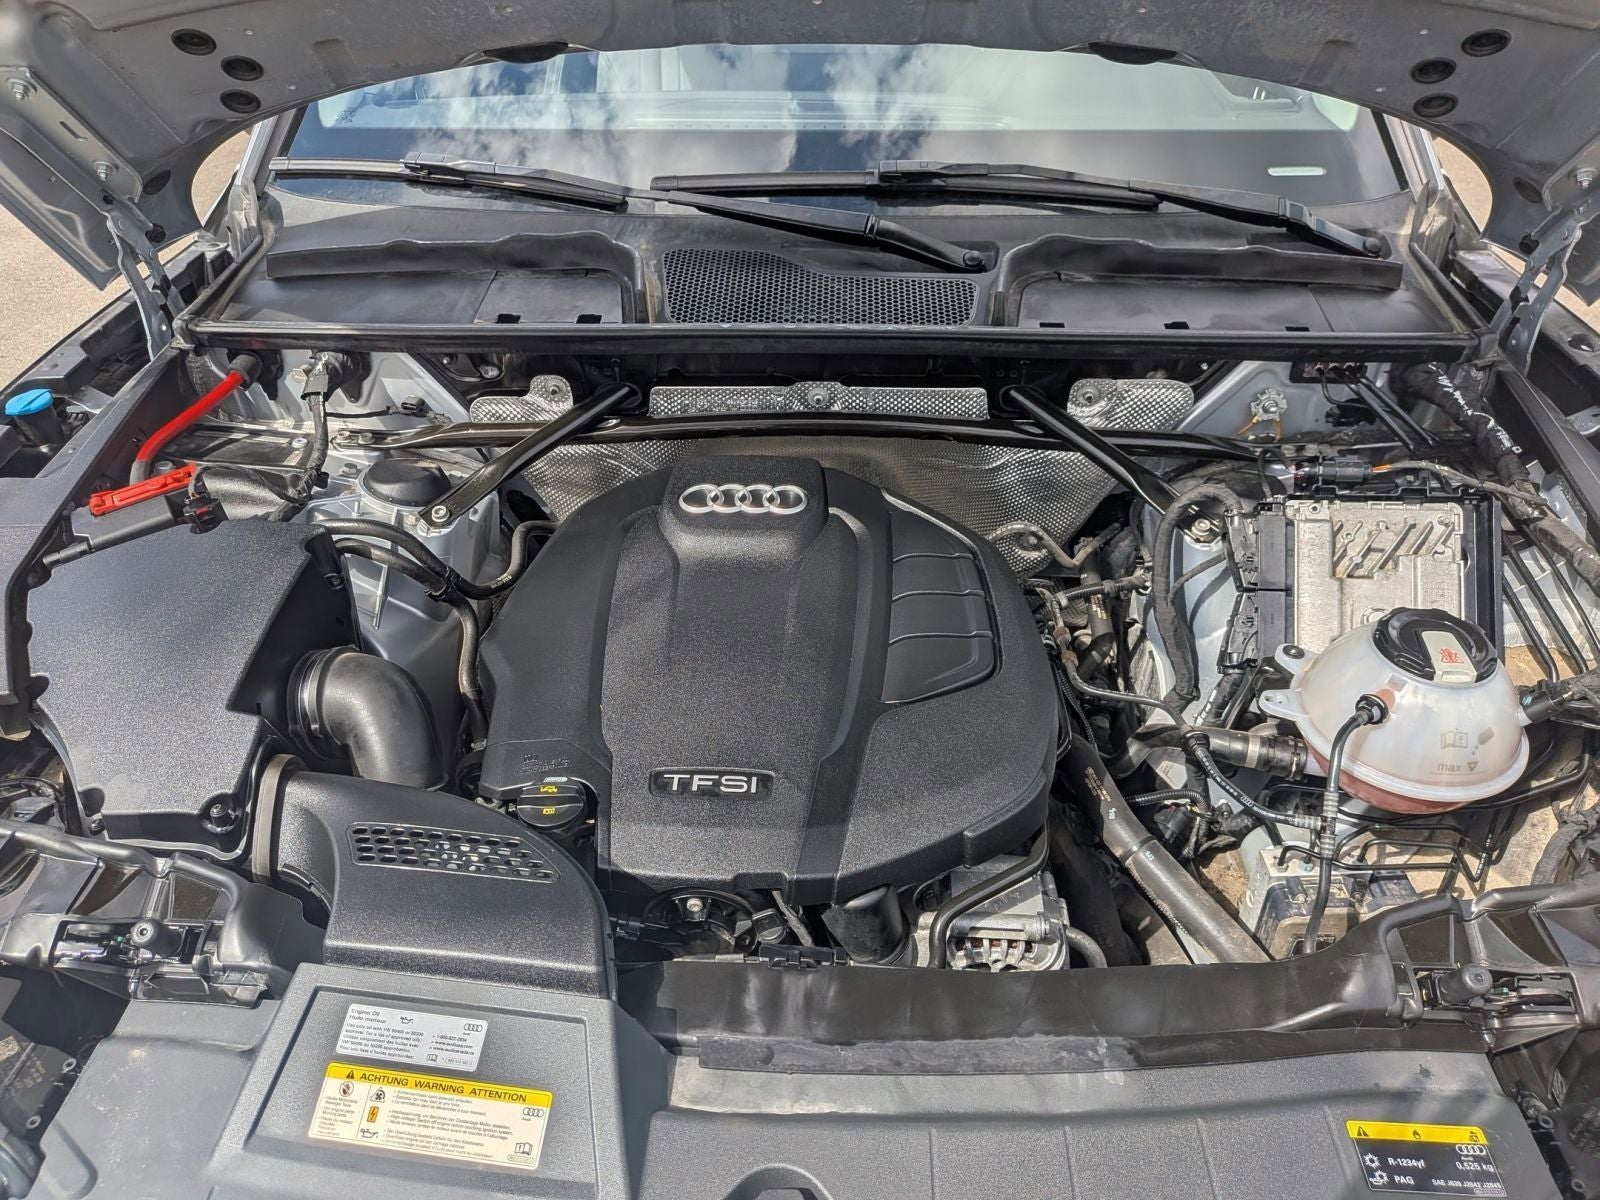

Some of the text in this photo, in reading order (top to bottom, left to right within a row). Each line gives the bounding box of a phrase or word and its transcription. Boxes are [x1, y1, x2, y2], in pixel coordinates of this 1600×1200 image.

[1437, 763, 1463, 772] max
[663, 774, 758, 794] TFSI
[360, 1072, 528, 1102] ACHTUNG WARNING ATTENTION
[1388, 1157, 1426, 1169] R-1234yf
[1482, 1162, 1495, 1173] kg
[1393, 1175, 1415, 1185] PAG
[1431, 1178, 1446, 1186] SAE
